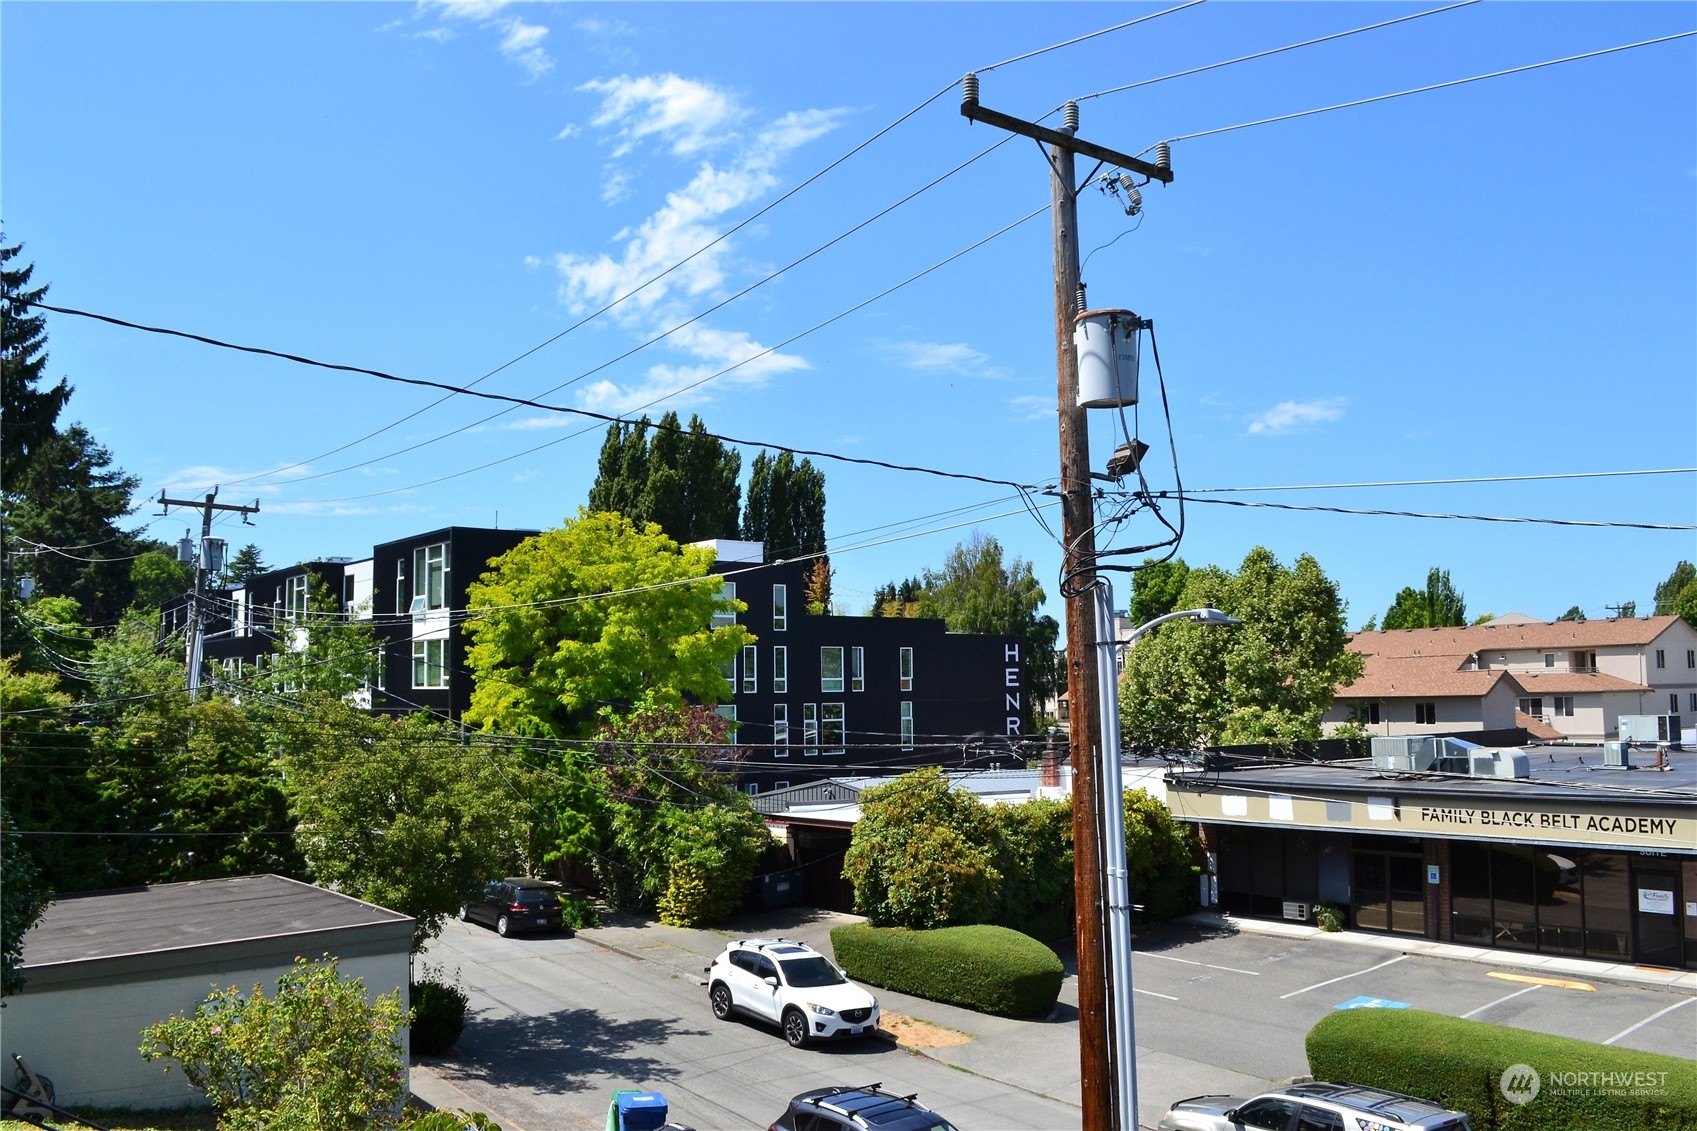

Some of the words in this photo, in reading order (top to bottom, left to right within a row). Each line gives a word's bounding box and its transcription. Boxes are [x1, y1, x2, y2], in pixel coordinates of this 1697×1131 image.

[1421, 808, 1475, 824] FAMILY
[1481, 810, 1535, 828] BLACK
[1540, 814, 1580, 829] BELT
[1586, 816, 1677, 835] ACADEMY
